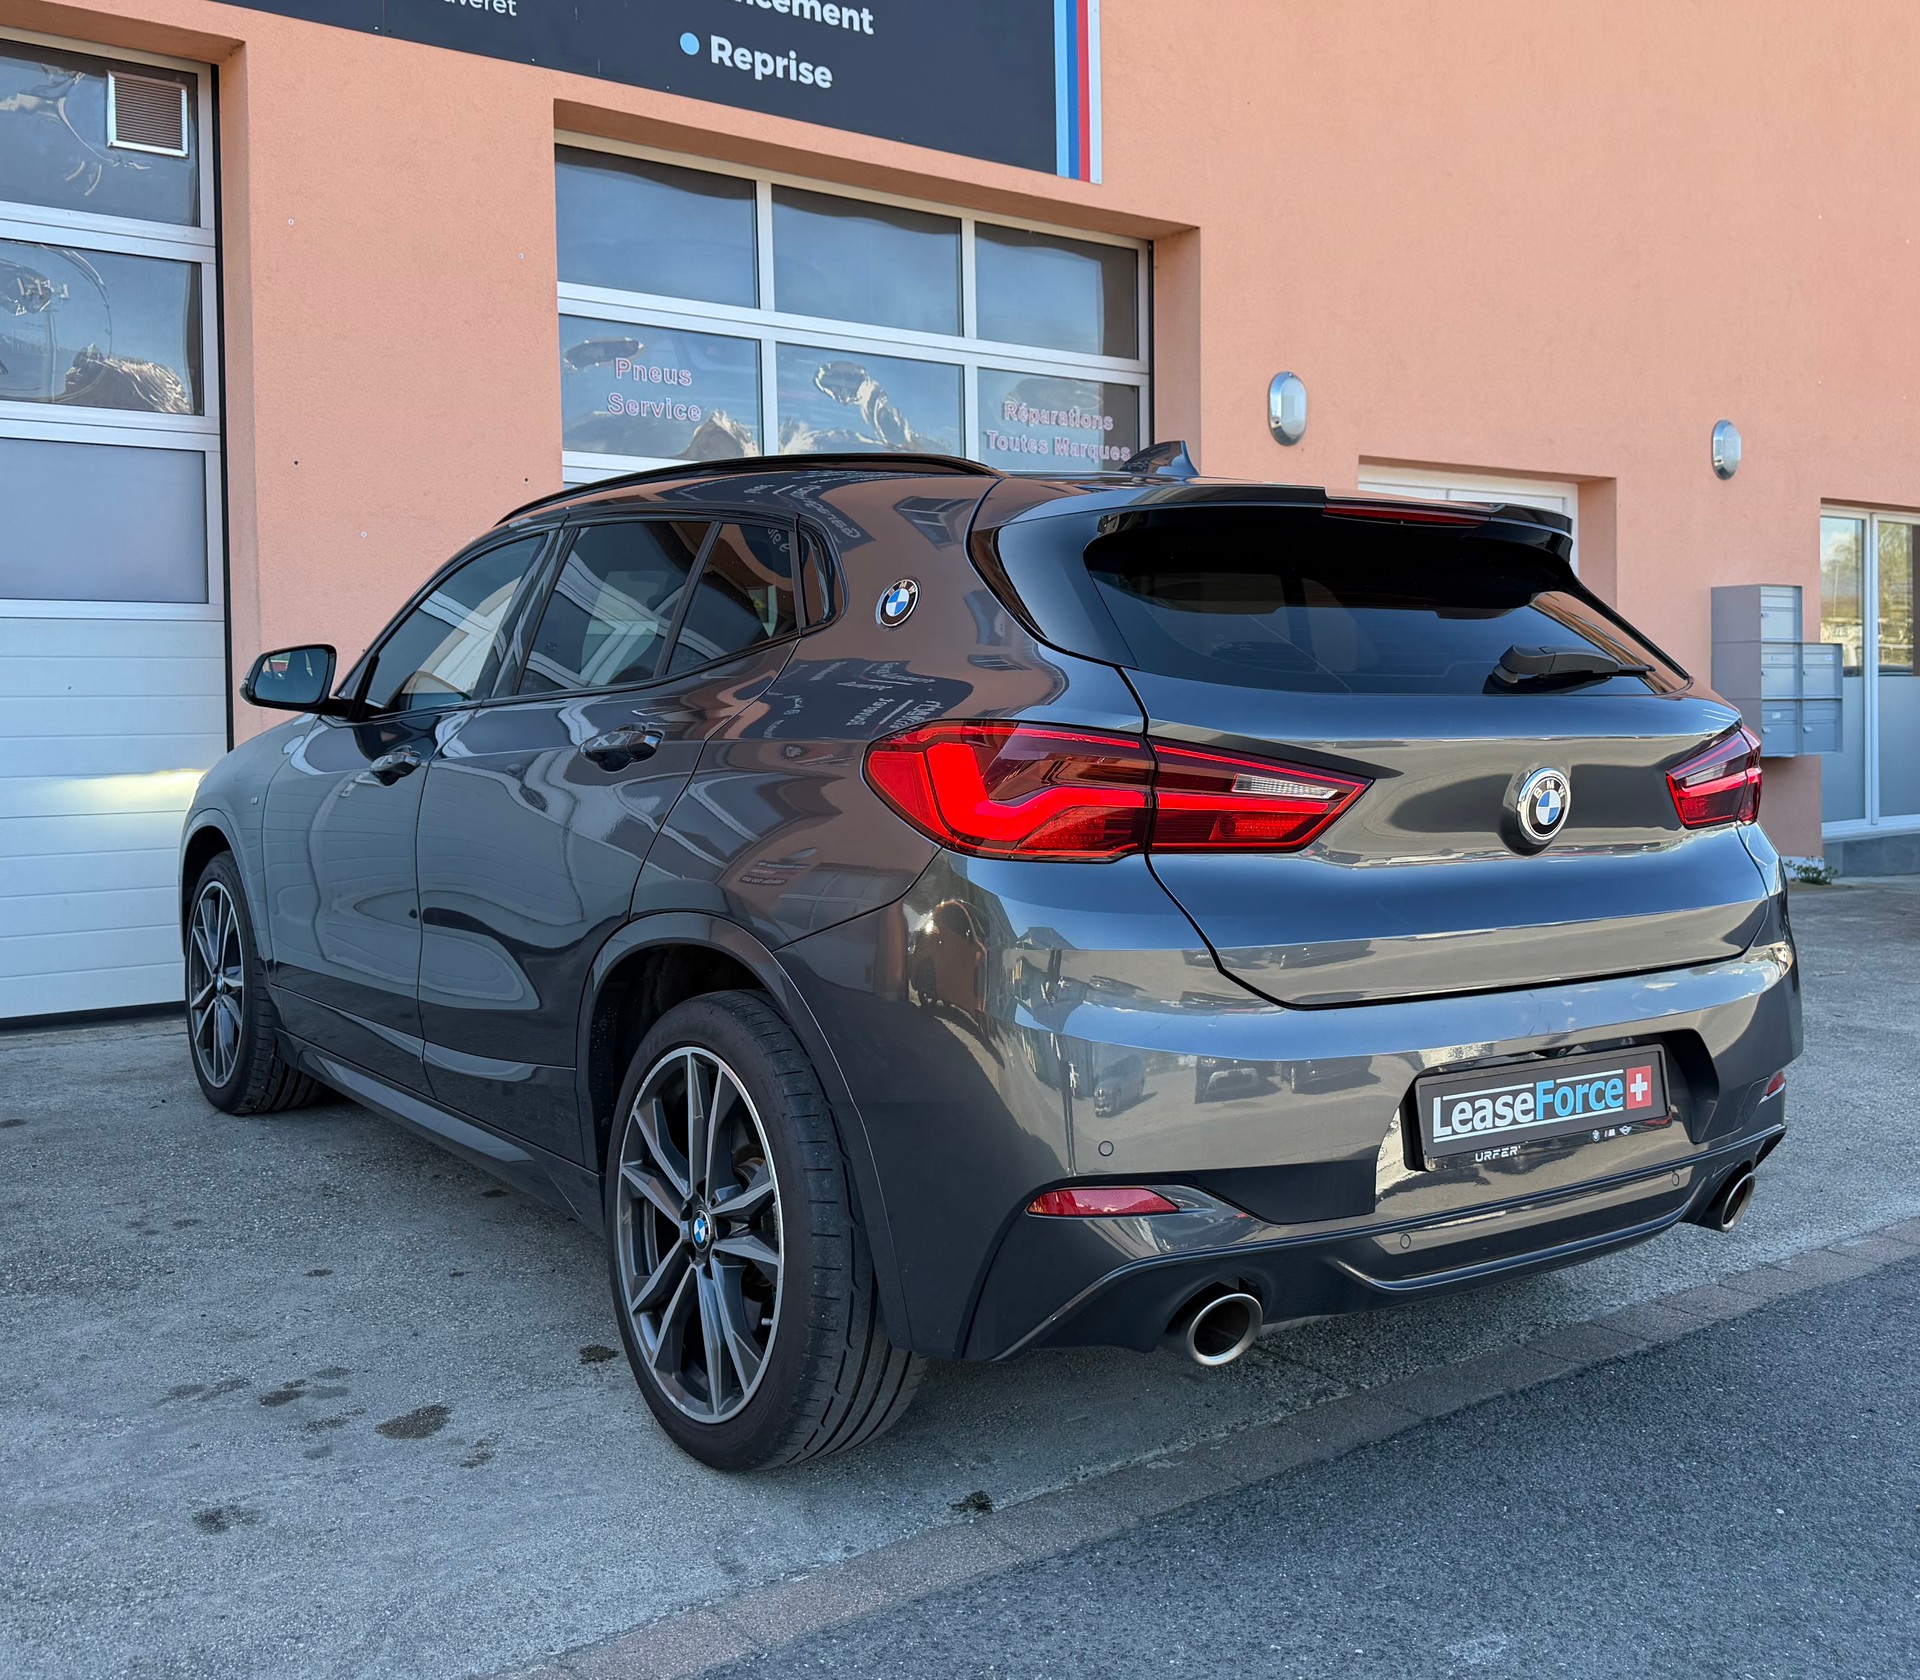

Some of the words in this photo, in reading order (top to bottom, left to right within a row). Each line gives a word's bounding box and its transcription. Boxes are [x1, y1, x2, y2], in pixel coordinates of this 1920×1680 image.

[710, 34, 833, 89] Reprise
[615, 357, 693, 386] Pneus
[608, 392, 702, 421] Service
[1004, 400, 1114, 431] Réparations
[986, 430, 1048, 455] Toutes
[1053, 436, 1131, 463] Marques
[1433, 1077, 1624, 1137] LeaseForce
